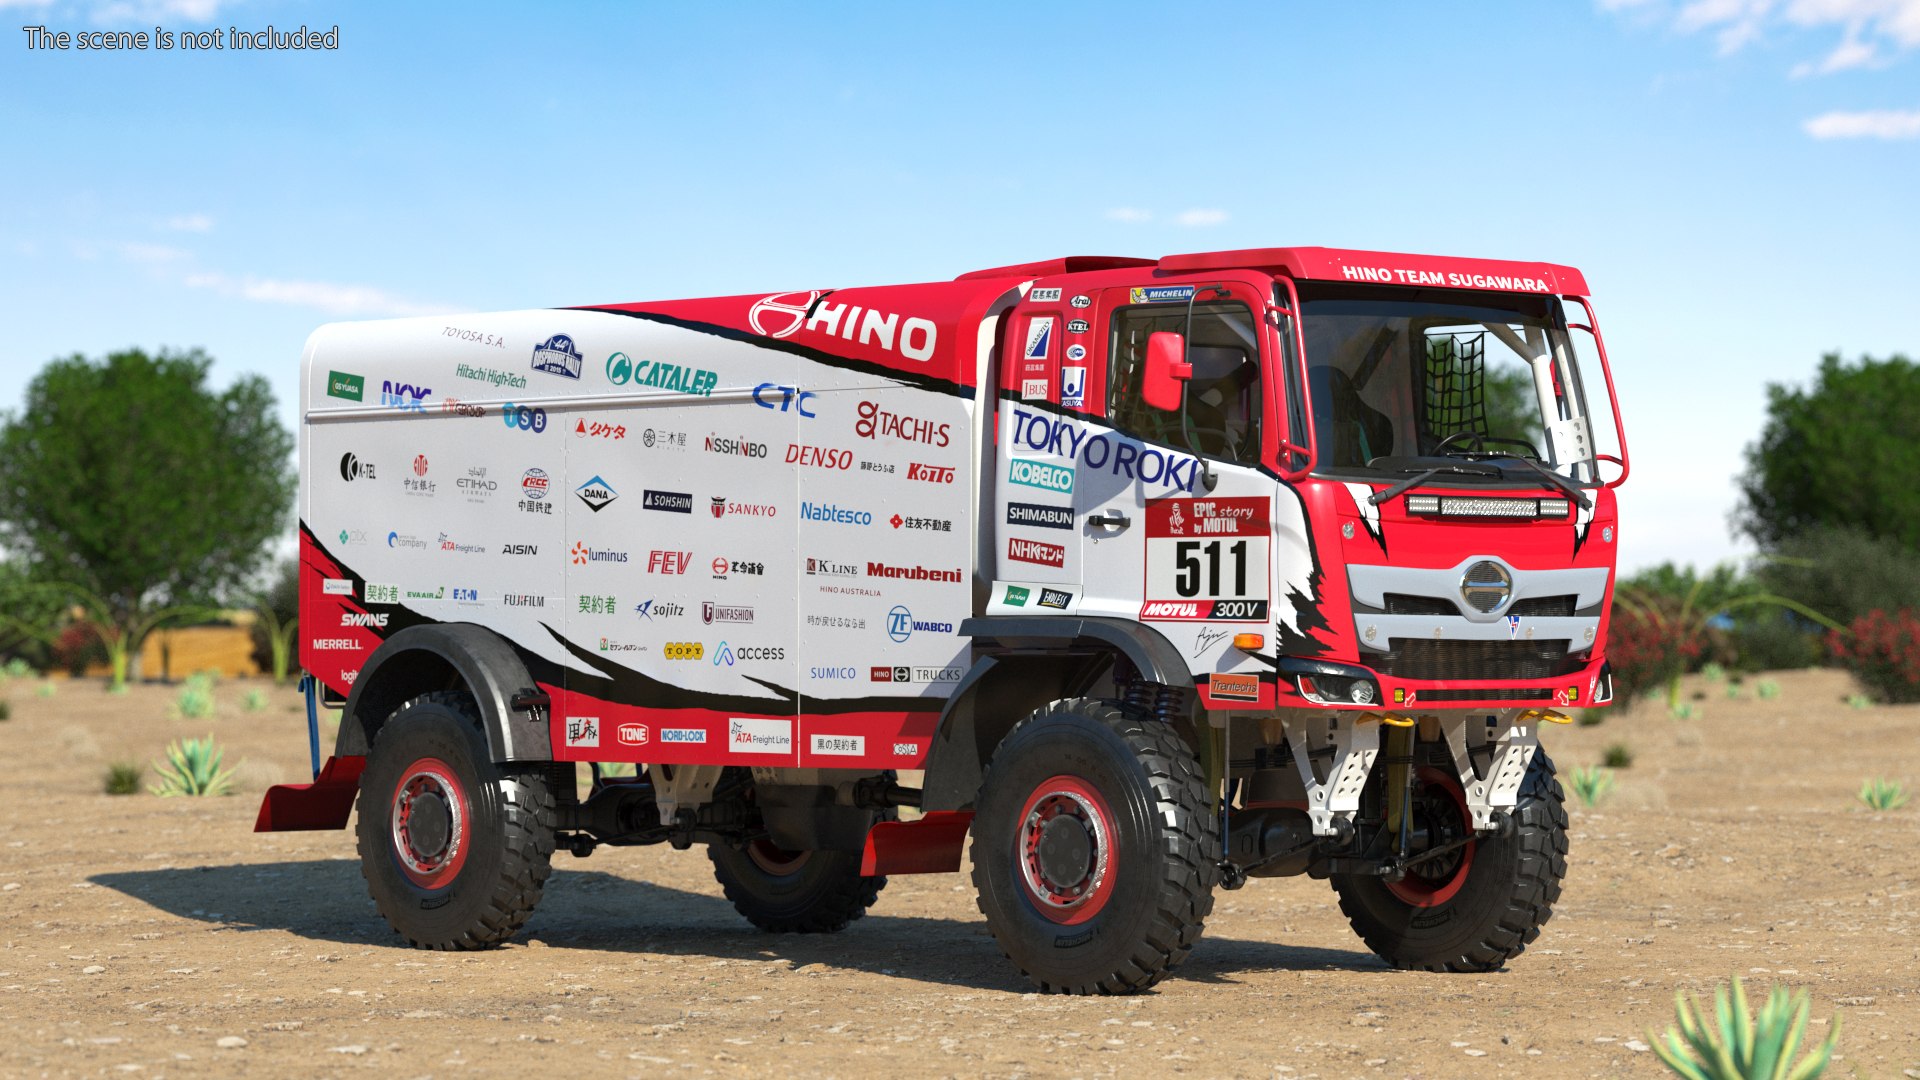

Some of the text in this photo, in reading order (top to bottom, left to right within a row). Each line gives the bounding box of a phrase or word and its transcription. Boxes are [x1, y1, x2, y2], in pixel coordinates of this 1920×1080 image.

[1343, 265, 1549, 292] HINO TEAM SUGAWARA
[1150, 289, 1194, 299] MICHELIN
[442, 327, 506, 349] TOYOSA S.A.
[806, 300, 937, 362] HINO
[1026, 321, 1050, 356] OKAMOTO
[456, 363, 527, 389] Hitachi High-Tech
[634, 360, 718, 397] CATALER
[381, 380, 431, 413] NOK
[752, 382, 817, 418] CTC
[880, 411, 950, 447] TACHI-S
[785, 443, 853, 470] DENSO
[1013, 410, 1199, 493] TOKYO ROKI
[358, 464, 377, 479] K-TEL
[1011, 461, 1073, 489] KOBELCO
[456, 478, 498, 491] ETIHAD
[584, 488, 609, 500] DANA
[653, 494, 692, 509] SOHSHIN
[728, 502, 777, 517] SANKYO
[801, 501, 872, 526] Nabtesco
[1009, 507, 1073, 524] SHIMABUN
[1193, 502, 1254, 520] EPIC story
[904, 516, 952, 532] 住友不動産
[1193, 517, 1239, 534] by MOTUL
[399, 539, 427, 550] company
[441, 541, 455, 551] ATA
[502, 544, 538, 555] AISIN
[588, 548, 628, 563] luminus
[648, 550, 693, 575] FEV
[832, 564, 858, 575] LINE
[867, 561, 962, 583] Marubeni
[1176, 541, 1246, 597] 511
[820, 586, 881, 597] HINO AUSTRALIA
[504, 594, 544, 607] FUJIFILM
[579, 594, 616, 615] 契約者
[653, 603, 684, 619] sojitz
[715, 608, 754, 621] UNIFASHION
[1144, 603, 1198, 616] MOTUL
[340, 613, 389, 627] SWANS
[912, 621, 953, 633] WABCO
[667, 647, 702, 655] TOPY
[737, 646, 785, 661] access
[811, 667, 856, 680] SUMICO
[873, 670, 890, 678] HINO
[916, 669, 960, 681] TRUCKS
[620, 727, 647, 742] TONE
[662, 730, 705, 742] NORD-LOCK
[736, 732, 790, 746] ATA Freight Line
